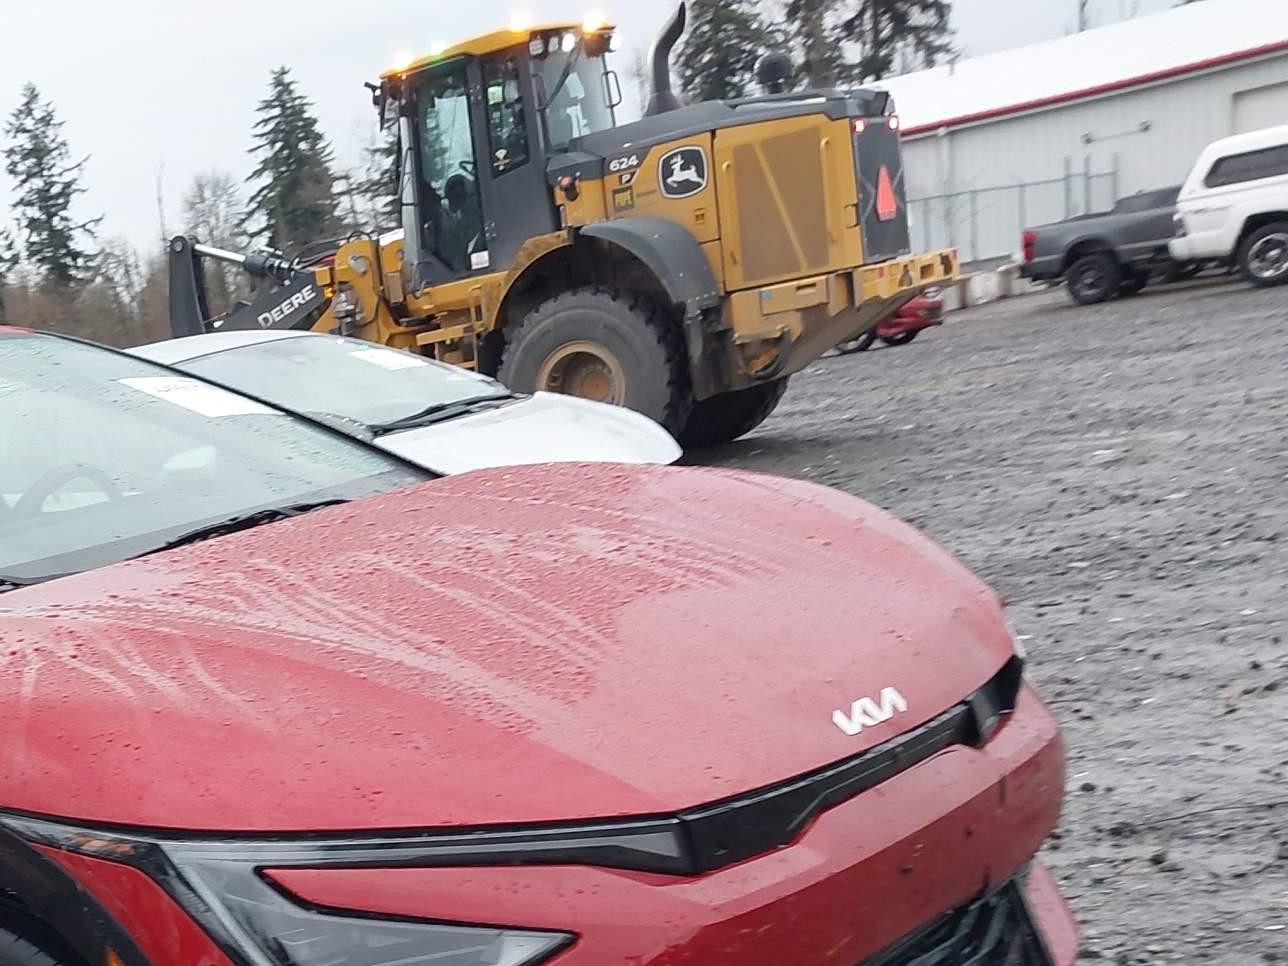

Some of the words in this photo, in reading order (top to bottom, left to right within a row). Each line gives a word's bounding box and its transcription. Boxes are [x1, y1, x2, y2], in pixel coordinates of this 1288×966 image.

[609, 155, 639, 172] 624
[257, 284, 317, 329] DEERE
[832, 686, 908, 736] KIA
